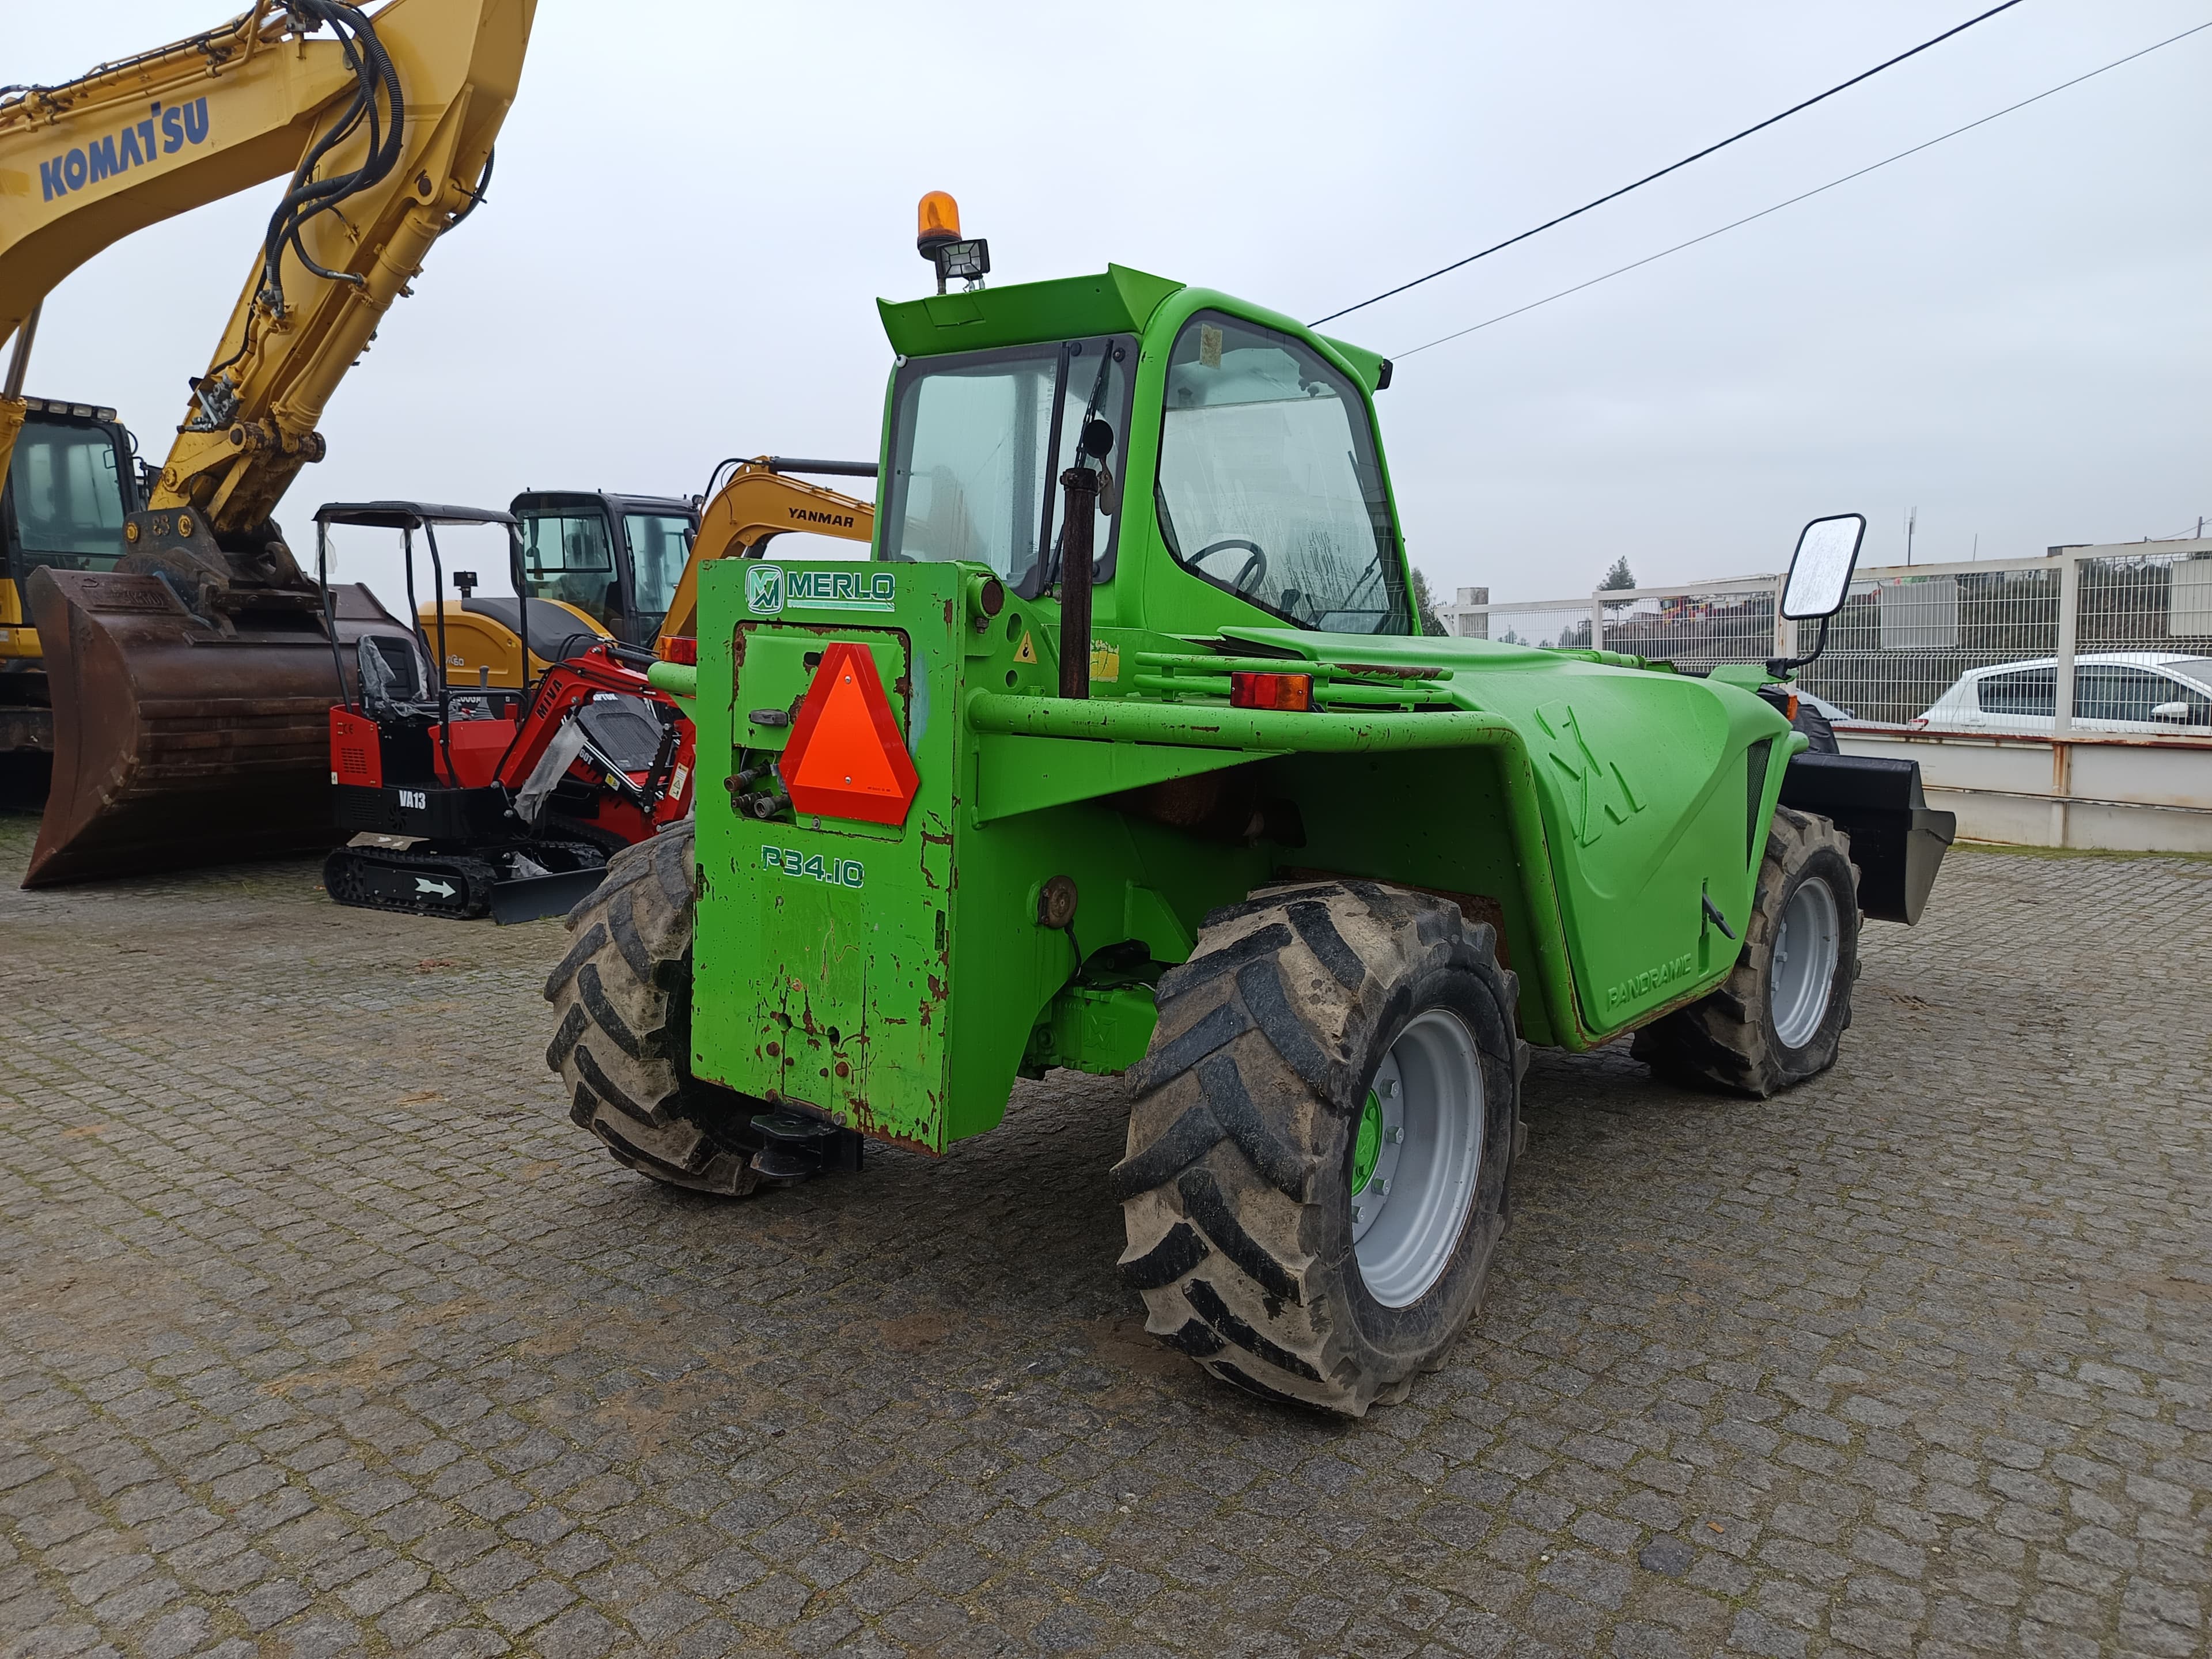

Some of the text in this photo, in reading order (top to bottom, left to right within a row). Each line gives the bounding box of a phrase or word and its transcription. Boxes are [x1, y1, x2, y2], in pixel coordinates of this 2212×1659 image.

[39, 96, 209, 203] KOMATSU
[788, 507, 854, 528] YANMAR
[787, 571, 896, 600] MERLO
[535, 679, 563, 720] MIVA
[399, 789, 426, 810] VA13
[761, 844, 865, 889] P34.10
[1607, 952, 1691, 1013] PANORAMIC
